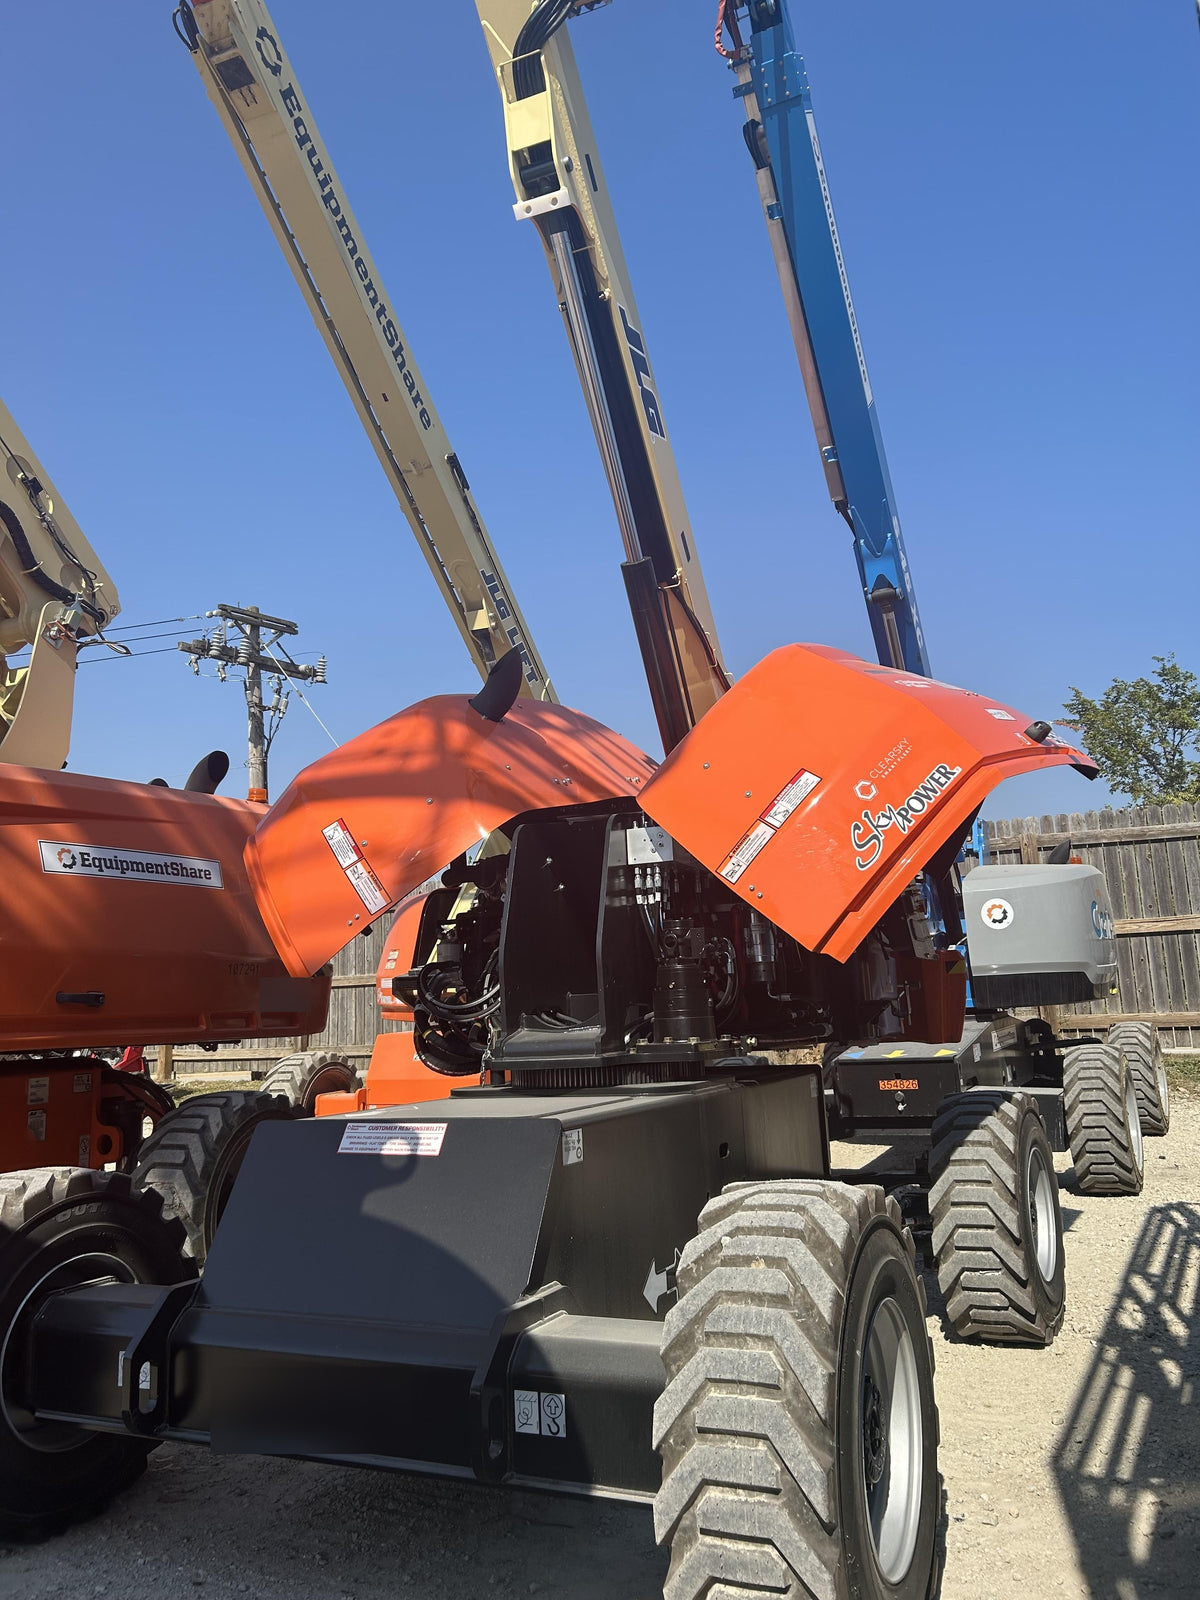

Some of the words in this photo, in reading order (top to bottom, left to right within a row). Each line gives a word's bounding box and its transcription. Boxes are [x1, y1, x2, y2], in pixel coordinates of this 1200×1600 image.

[279, 82, 432, 431] EquipmentShare
[617, 303, 666, 440] JLG
[480, 568, 511, 621] JLG
[869, 738, 909, 778] CLEARSKY
[881, 761, 898, 778] SMART
[897, 745, 912, 762] FLEET
[78, 851, 212, 881] EquipmentShare
[880, 1080, 918, 1090] 354826
